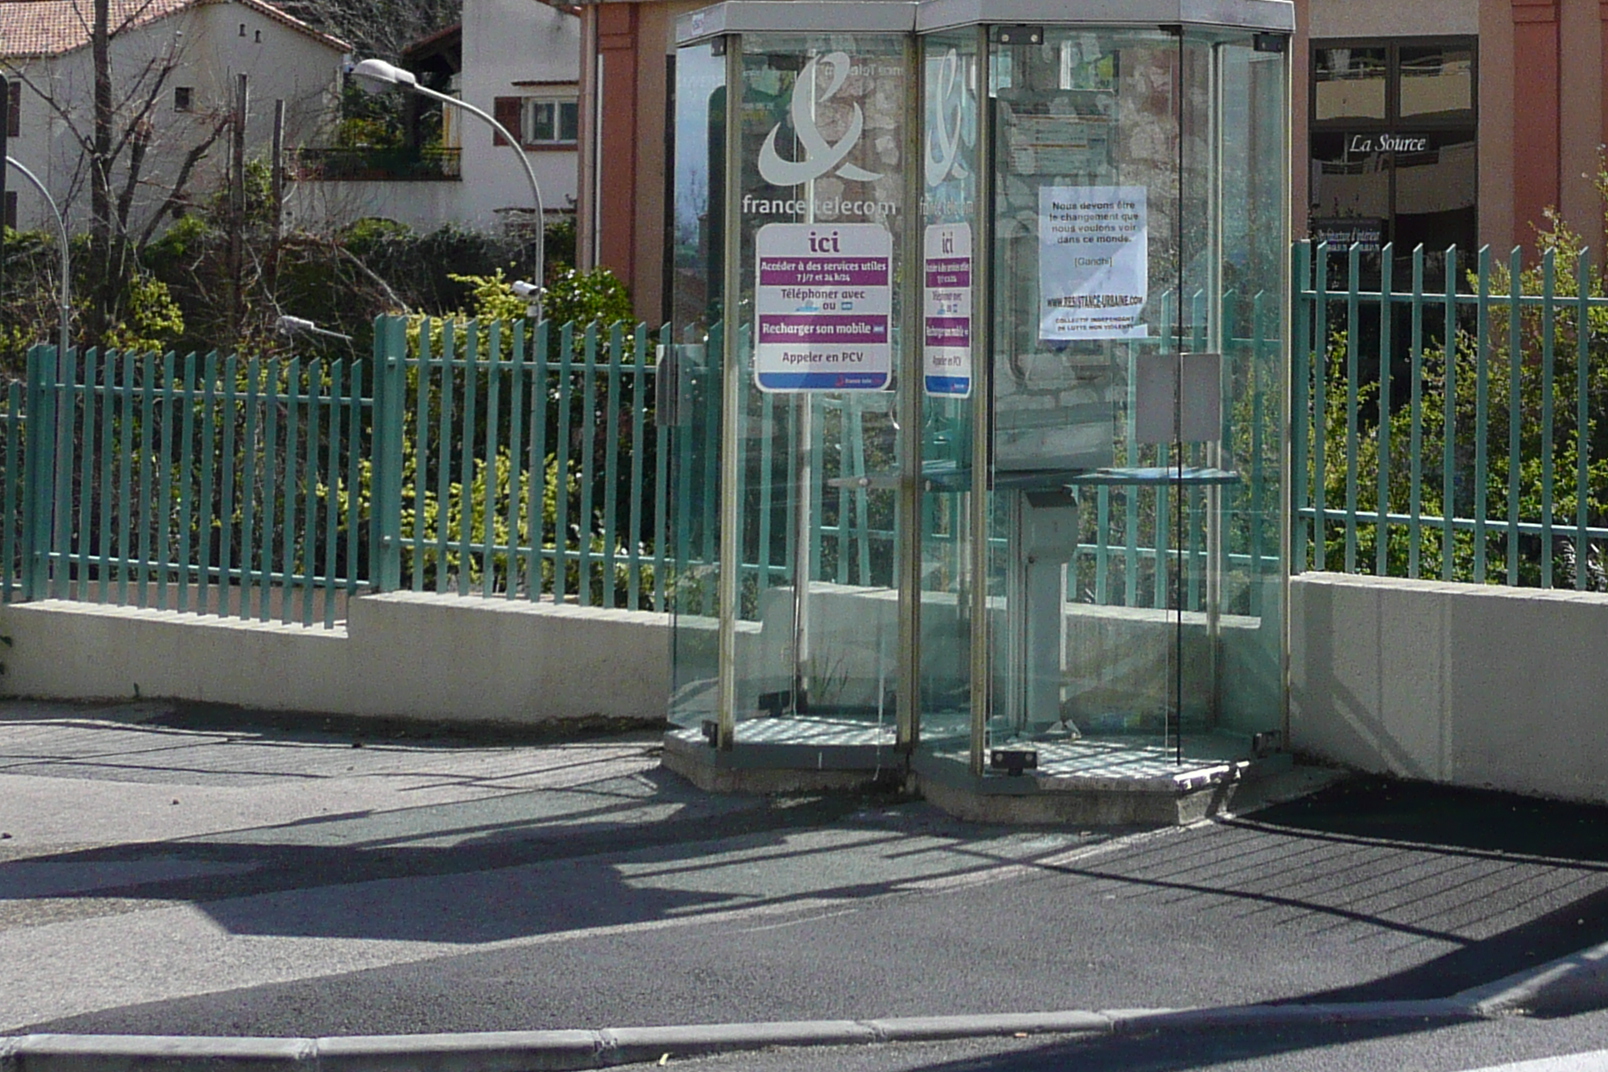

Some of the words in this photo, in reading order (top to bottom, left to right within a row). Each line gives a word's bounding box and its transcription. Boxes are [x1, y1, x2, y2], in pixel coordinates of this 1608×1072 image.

[1350, 135, 1371, 151] La
[1374, 133, 1426, 152] Source
[742, 195, 805, 214] france
[815, 196, 896, 215] telecom
[1052, 201, 1077, 210] Nous
[1079, 201, 1114, 210] devons
[1049, 213, 1058, 222] le
[1060, 213, 1119, 222] changement
[1121, 214, 1139, 222] que
[1052, 225, 1076, 233] nous
[1078, 224, 1116, 232] voulons
[1118, 223, 1136, 231] voir
[808, 231, 840, 253] ici
[942, 231, 953, 254] ici
[1057, 235, 1080, 244] dans
[761, 261, 796, 271] Accéder
[798, 261, 804, 271] à
[806, 261, 821, 271] des
[824, 262, 859, 271] services
[861, 261, 887, 271] utiles
[781, 288, 838, 302] Téléphoner
[841, 291, 866, 299] avec
[822, 302, 836, 310] ou
[762, 322, 814, 336] Recharger
[815, 325, 834, 334] son
[836, 322, 872, 334] mobile
[782, 351, 822, 365] Appeler
[826, 354, 839, 362] en
[842, 351, 864, 363] PCV
